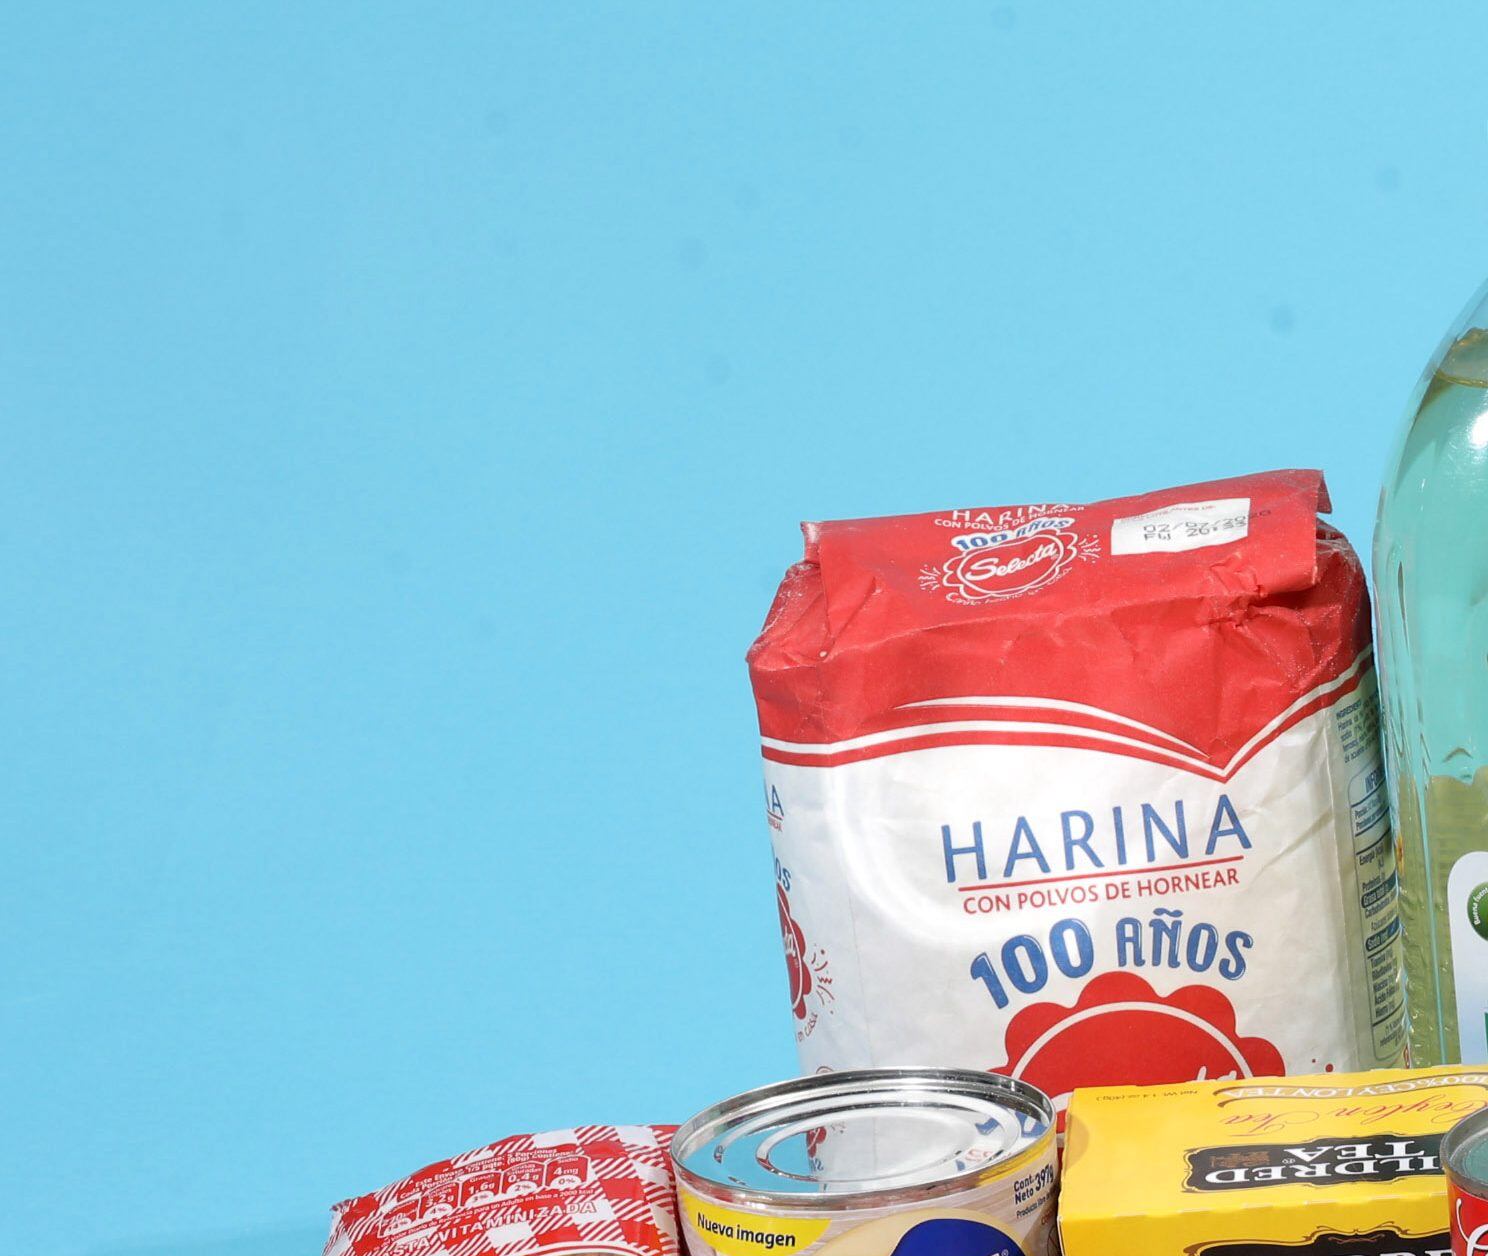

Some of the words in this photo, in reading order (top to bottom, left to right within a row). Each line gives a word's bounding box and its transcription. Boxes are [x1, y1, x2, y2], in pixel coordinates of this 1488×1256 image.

[934, 518, 960, 529] CON
[962, 520, 1009, 531] POLVOS
[1011, 516, 1025, 526] DE
[1026, 506, 1085, 521] HORNEAR
[956, 533, 1008, 551] 100
[965, 542, 1057, 581] Selecta
[941, 793, 1252, 883] HARINA
[962, 891, 1011, 916] CON
[1016, 884, 1099, 911] POLVOS
[1106, 880, 1132, 901] DE
[1136, 867, 1239, 898] HORNEAR
[1473, 900, 1481, 926] Buena
[970, 917, 1095, 1010] 100
[1114, 908, 1254, 982] AÑOS
[1284, 1141, 1425, 1159] TEA
[1205, 1154, 1440, 1185] ILDRED
[1015, 1188, 1034, 1204] Neto
[437, 1202, 598, 1243] VITAMINIZADA
[697, 1212, 733, 1239] Nueva
[736, 1224, 795, 1248] imagen
